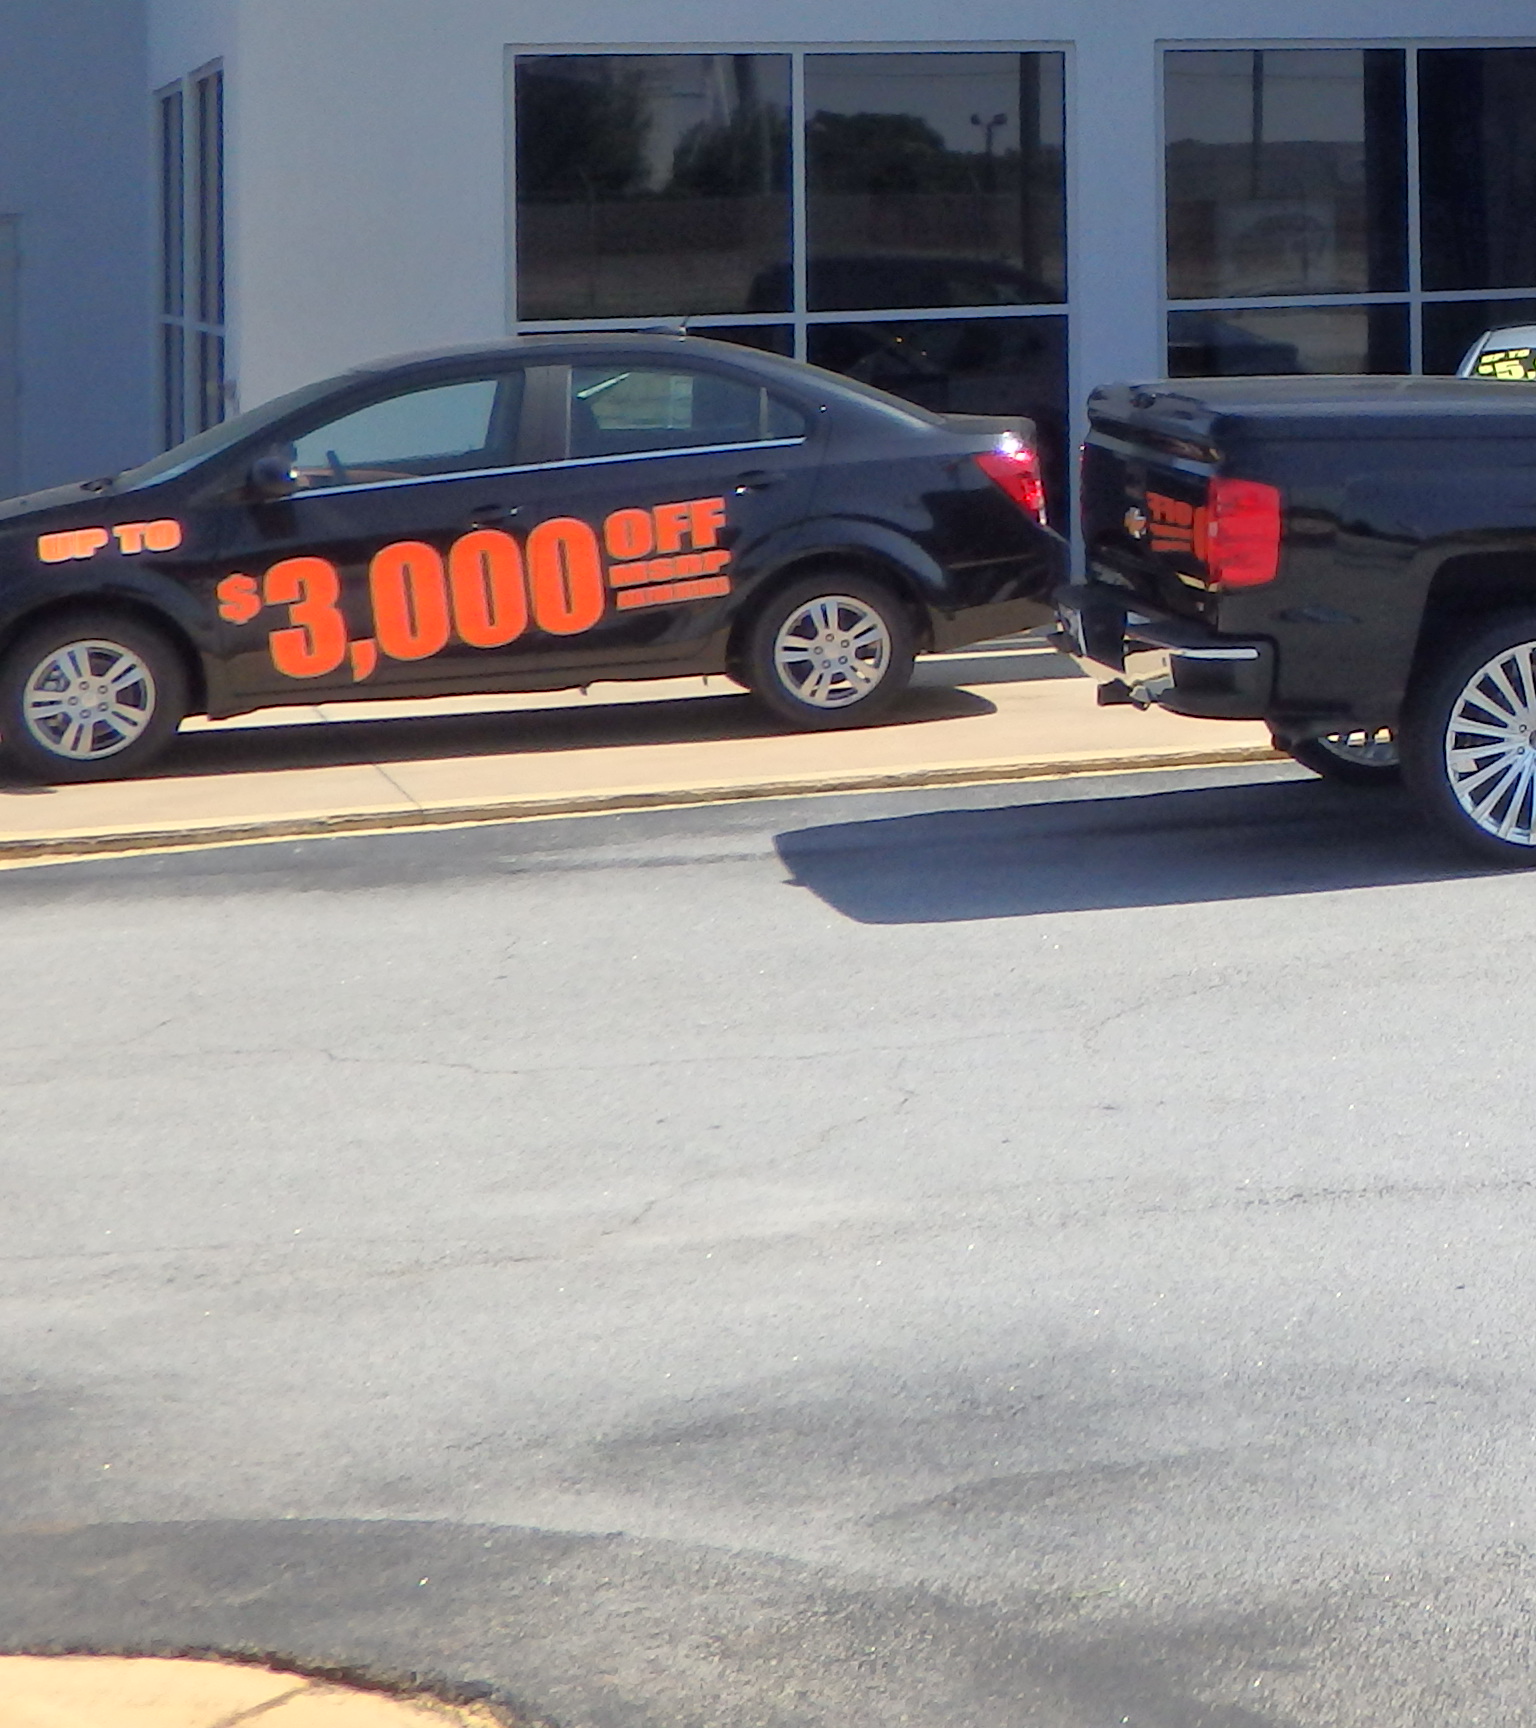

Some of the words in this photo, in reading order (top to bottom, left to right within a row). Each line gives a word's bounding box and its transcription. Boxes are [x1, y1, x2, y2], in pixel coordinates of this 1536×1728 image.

[38, 527, 109, 563] UP
[112, 518, 182, 555] TO
[216, 516, 605, 683] $3,000
[603, 496, 727, 561] OFF
